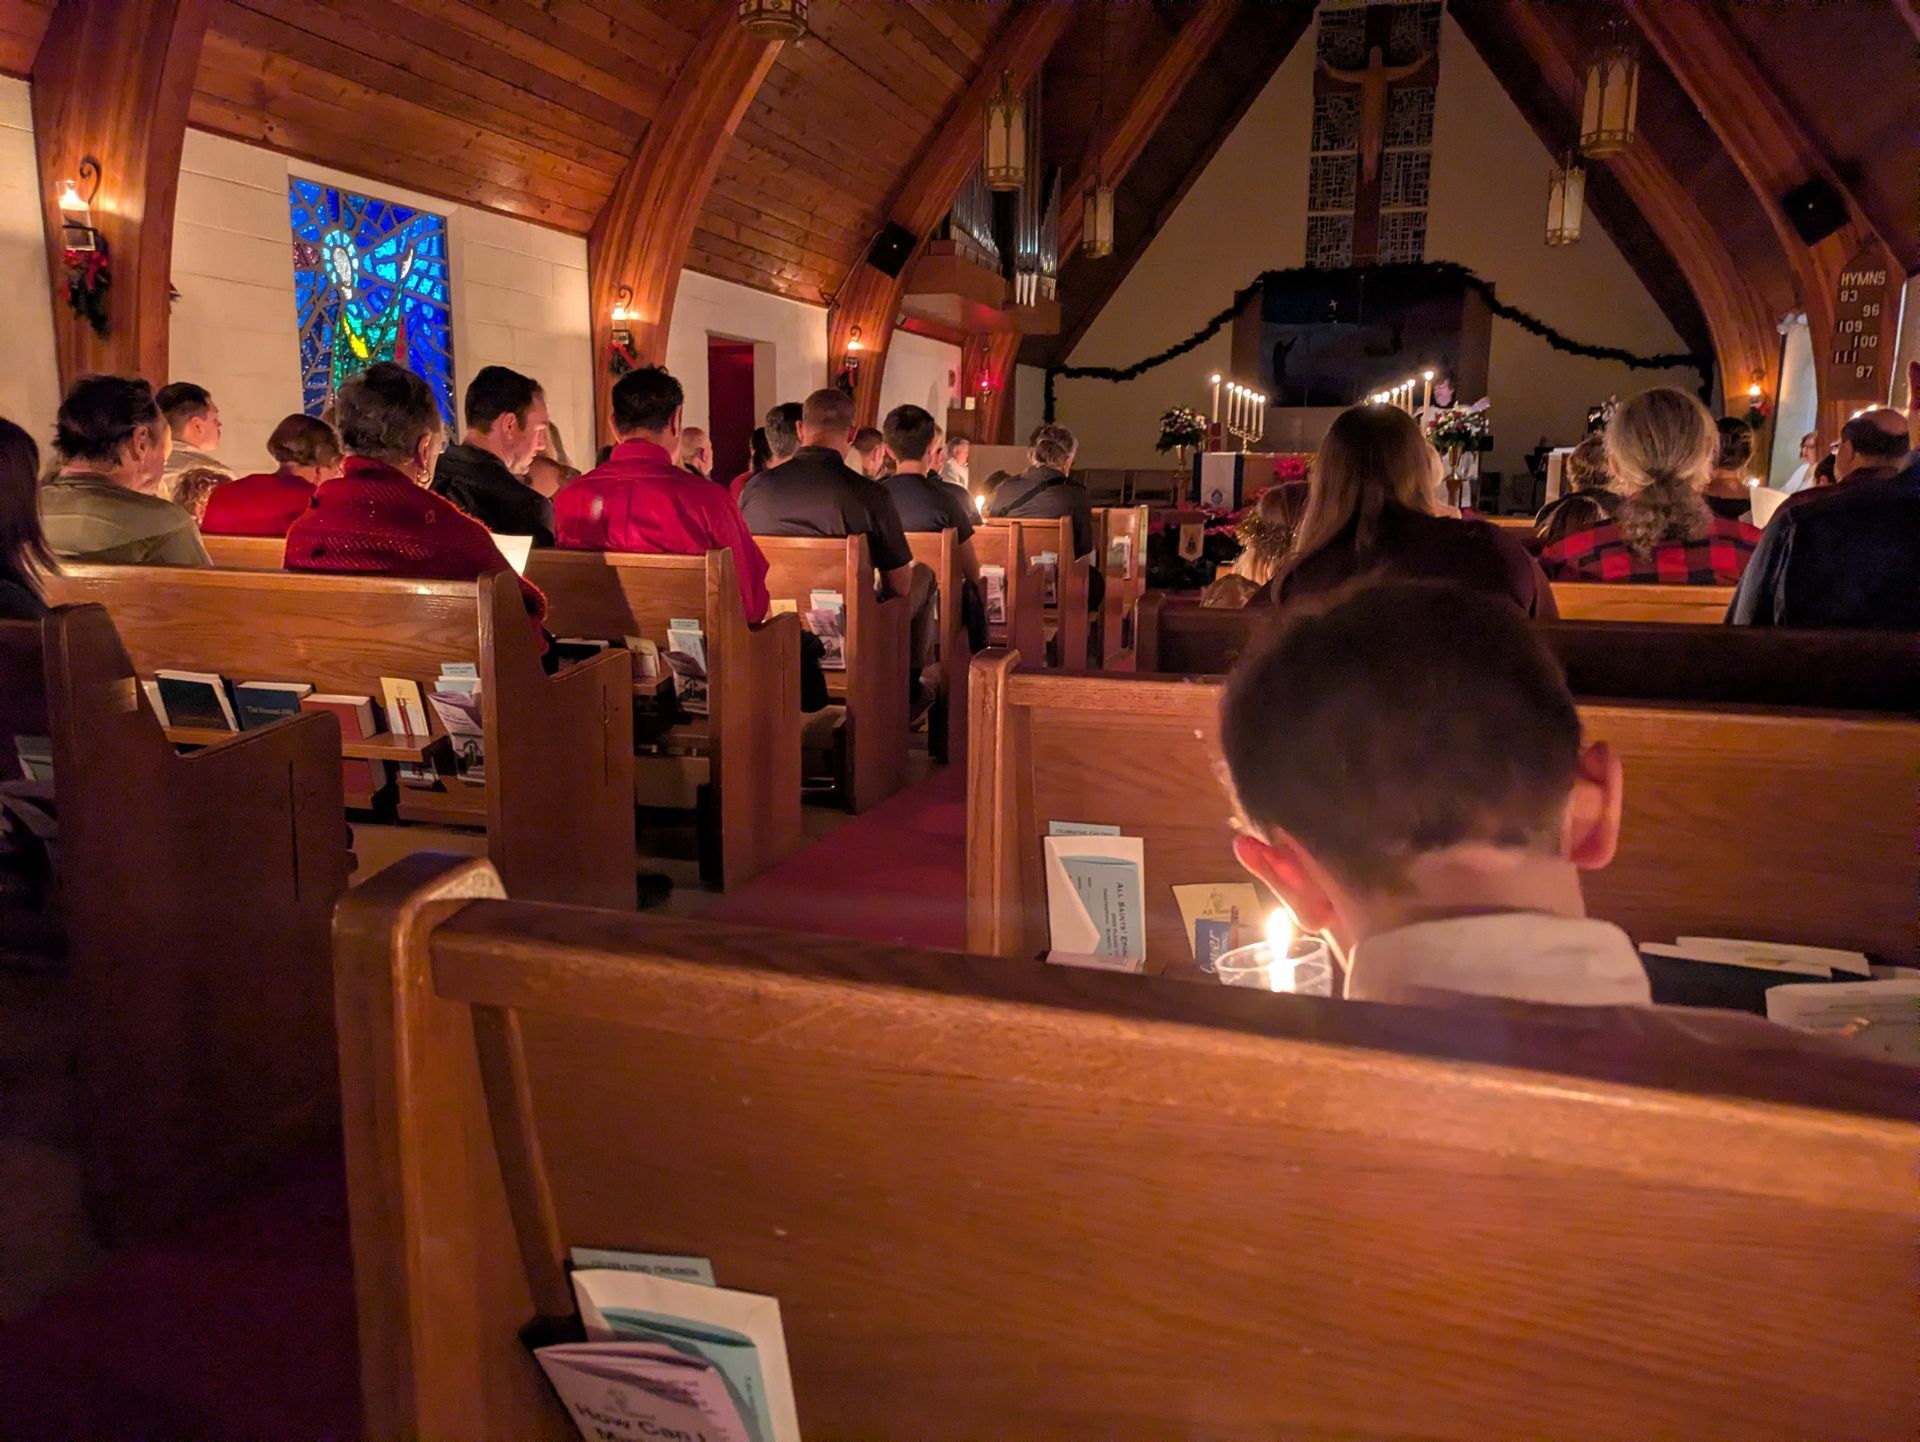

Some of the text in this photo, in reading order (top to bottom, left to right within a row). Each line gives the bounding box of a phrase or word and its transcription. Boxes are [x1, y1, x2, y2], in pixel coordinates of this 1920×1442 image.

[1840, 271, 1886, 286] HYMNS
[1840, 290, 1858, 303] 83
[1862, 304, 1880, 317] 96
[1838, 320, 1863, 333] 109
[1854, 335, 1877, 348] 100
[1835, 351, 1857, 364] 111
[1856, 365, 1873, 378] 87
[638, 1420, 692, 1442] Can
